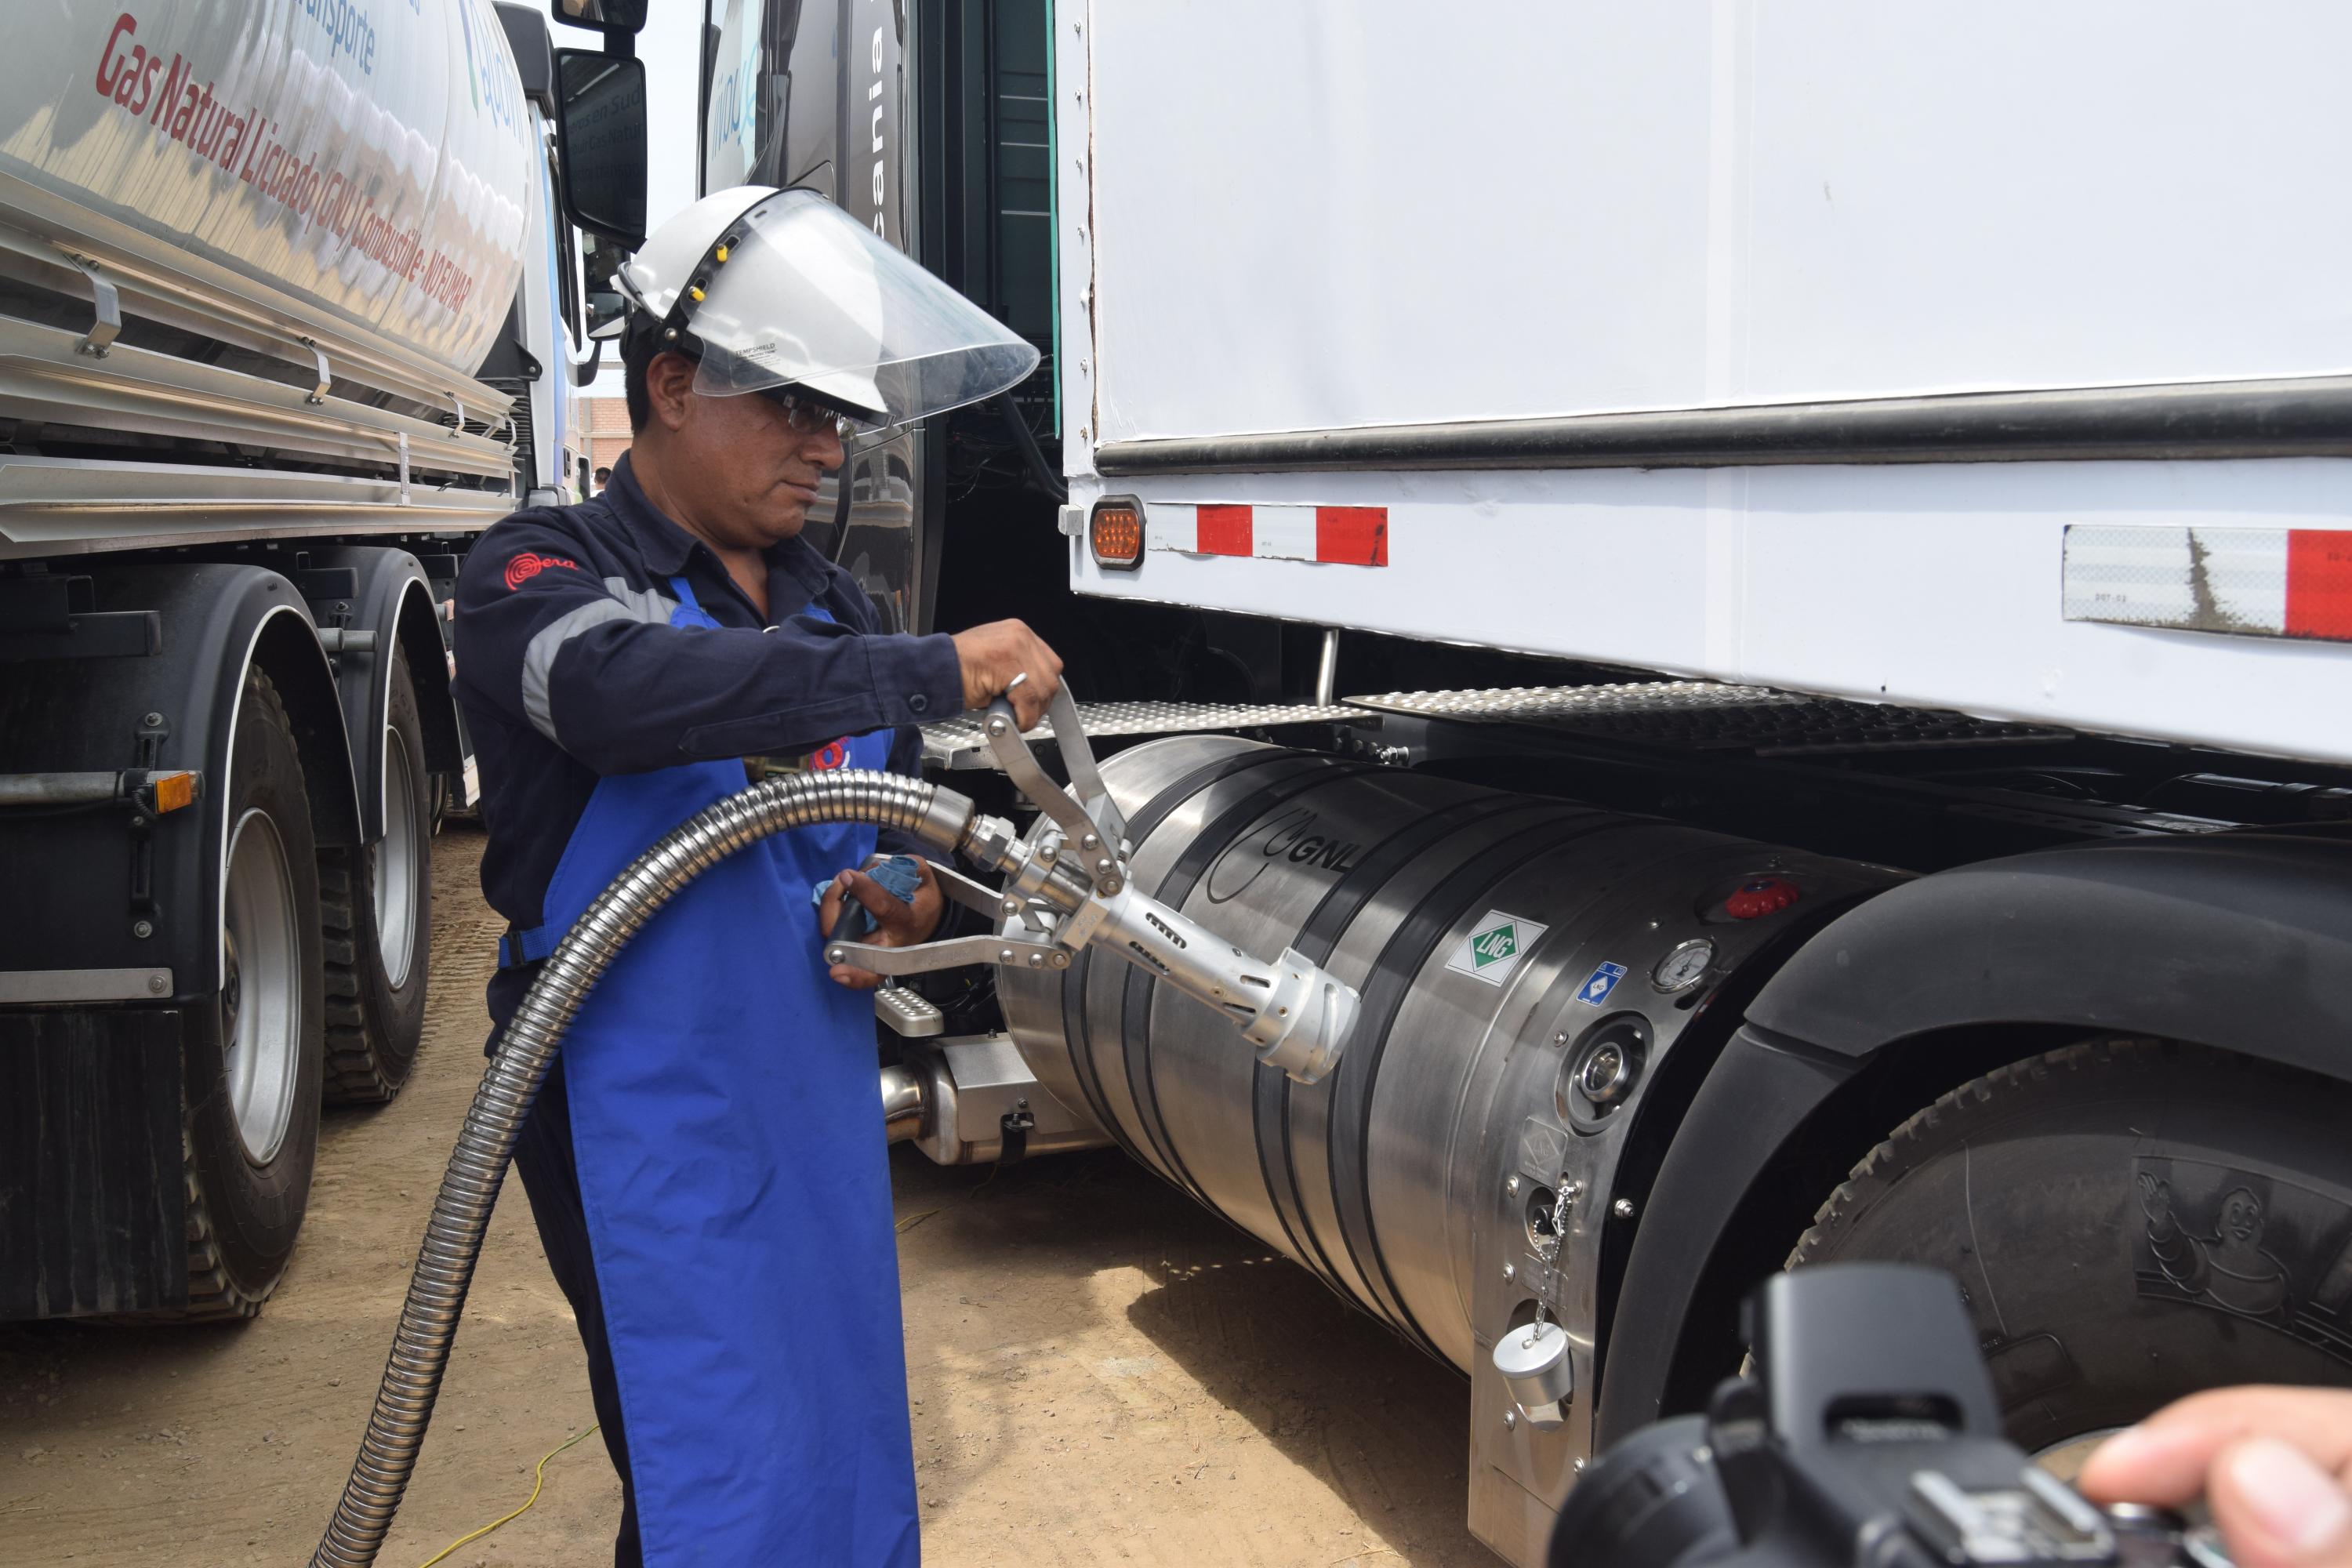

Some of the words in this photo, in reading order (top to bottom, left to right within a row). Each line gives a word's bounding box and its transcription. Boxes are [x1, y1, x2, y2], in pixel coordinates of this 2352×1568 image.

[96, 13, 162, 116] Gas
[150, 52, 257, 173] Natural
[869, 26, 884, 238] cania
[239, 117, 320, 215] Licuado
[305, 168, 363, 252] (GNL)
[350, 196, 425, 283] Combustible
[420, 249, 447, 296] NO
[433, 260, 473, 314] FUMAR
[1287, 835, 1363, 873] GNL
[1475, 931, 1513, 959] LNG
